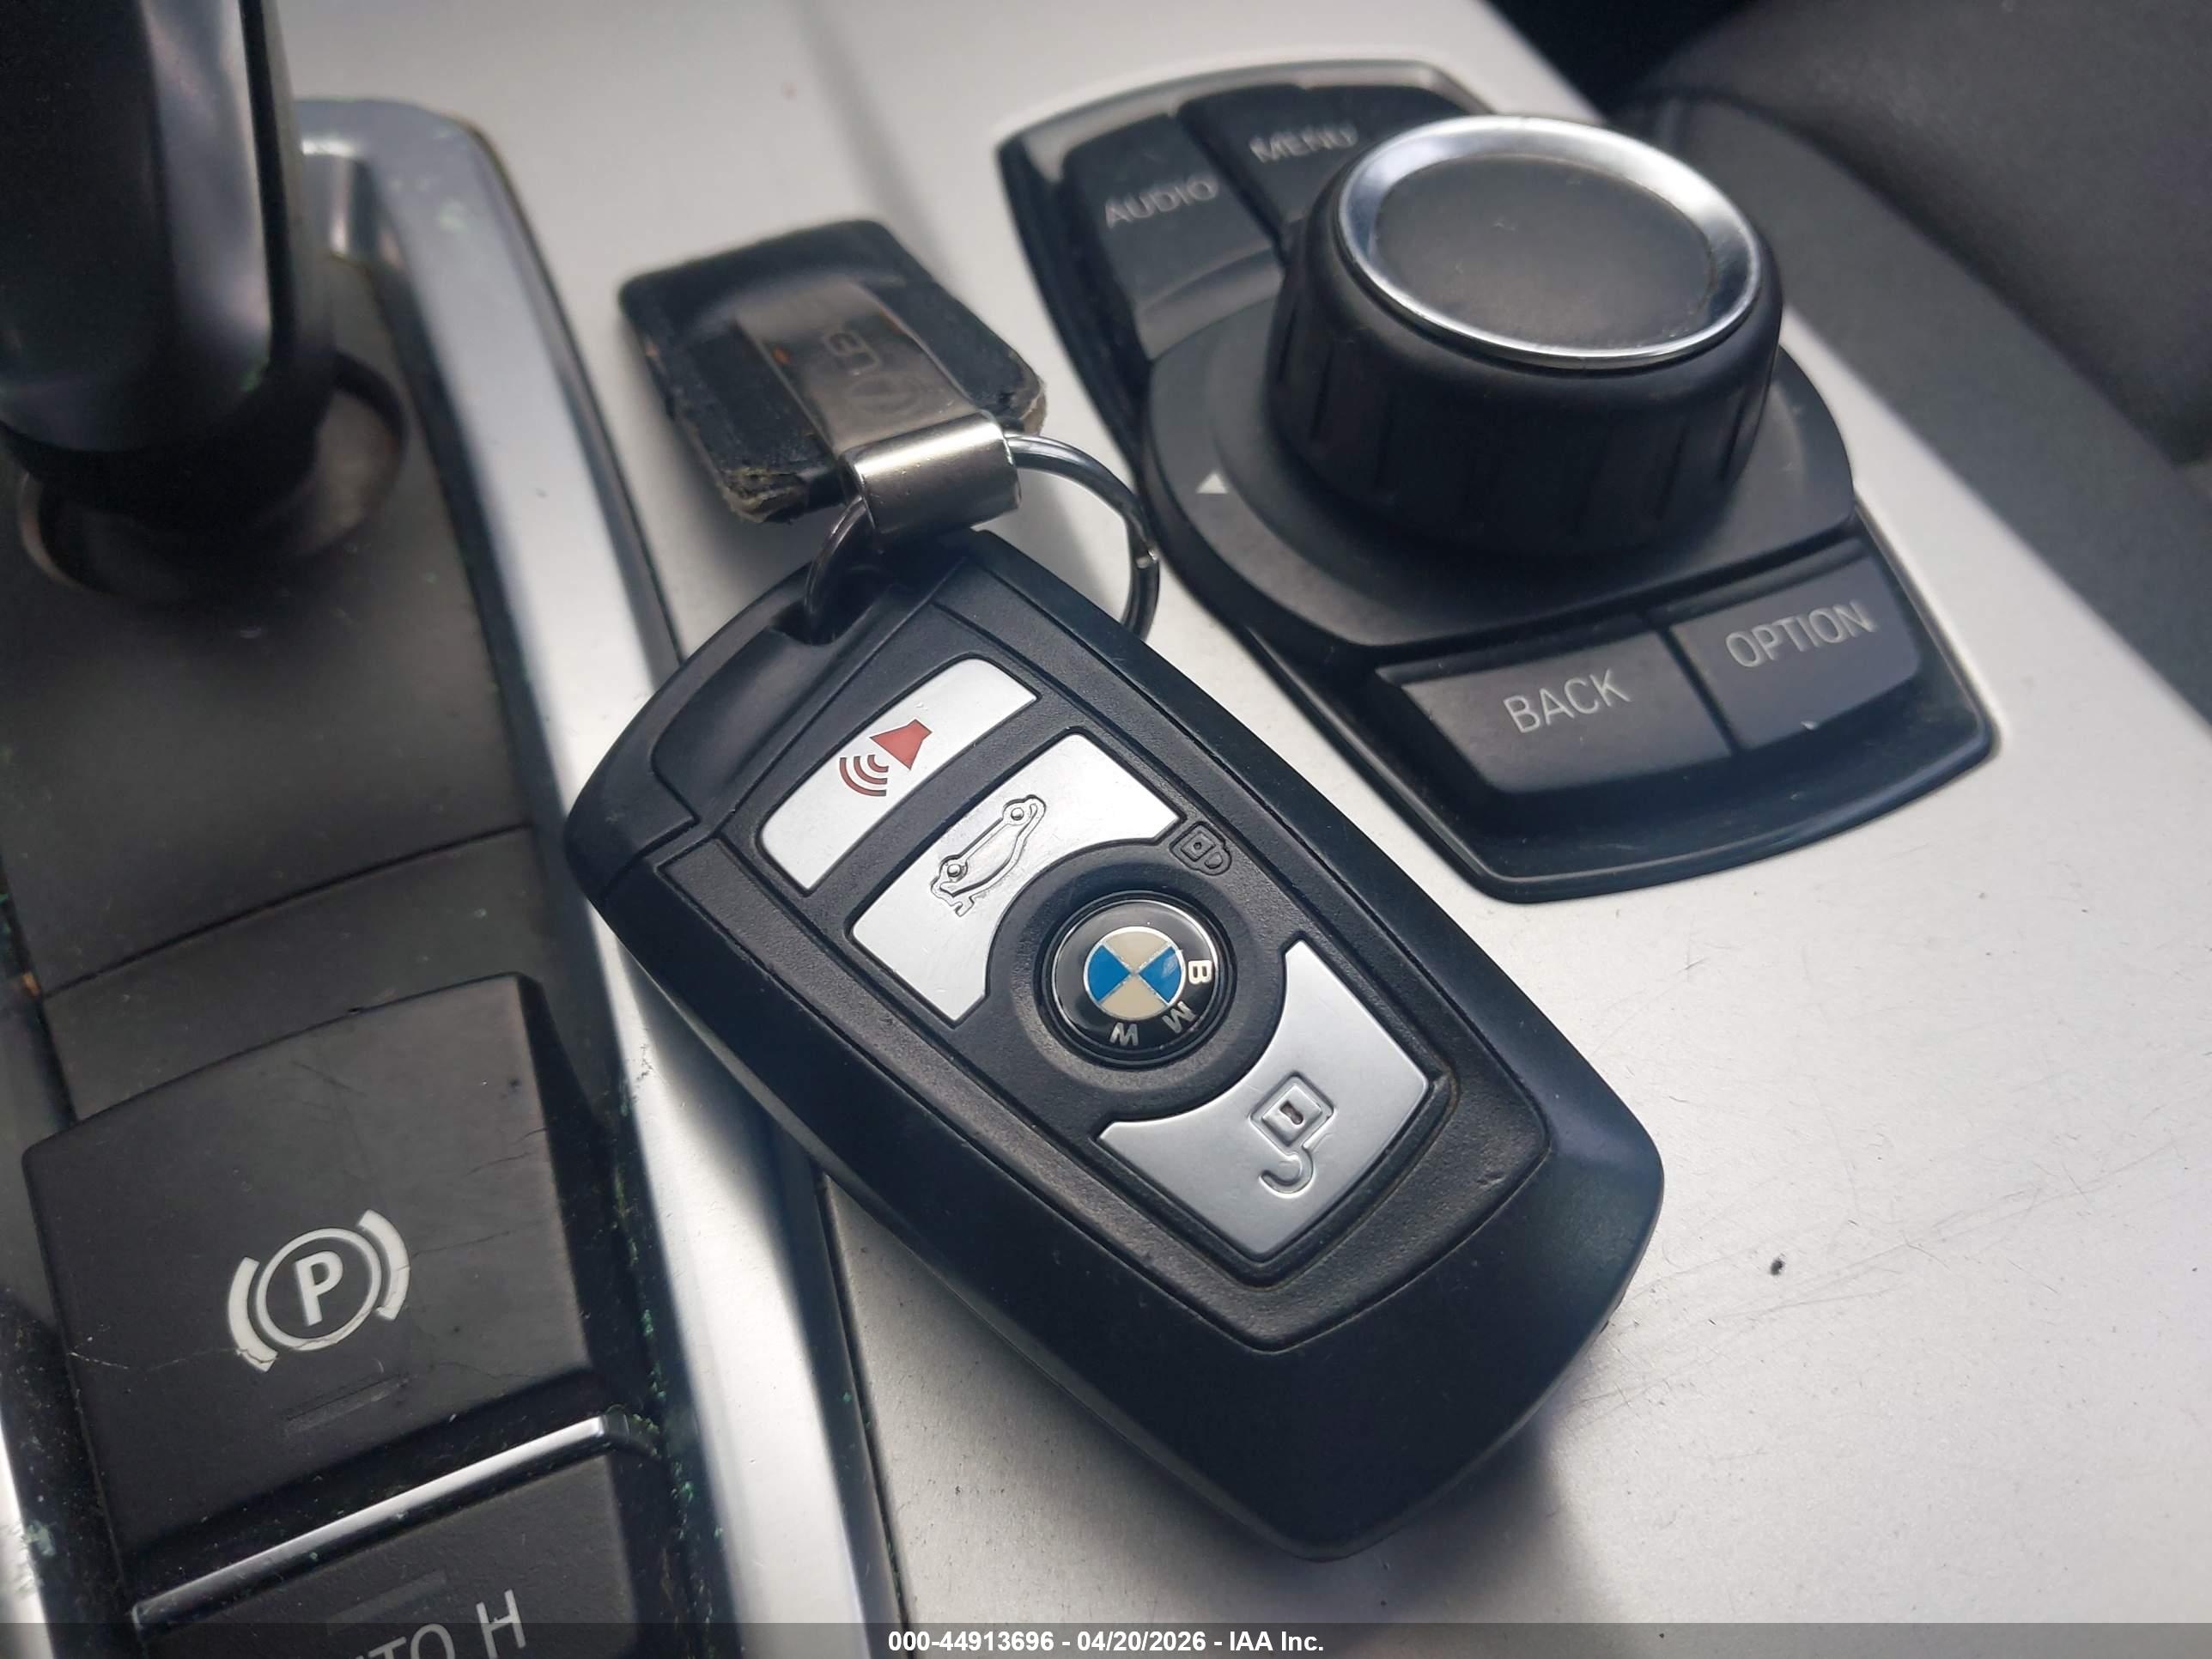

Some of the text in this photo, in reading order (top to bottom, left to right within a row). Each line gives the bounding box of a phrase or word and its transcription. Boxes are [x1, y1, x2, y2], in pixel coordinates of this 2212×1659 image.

[1248, 122, 1359, 163] MENU
[1104, 174, 1219, 229] AUDIO
[1724, 600, 1877, 668] OPTION
[1503, 669, 1630, 734] BACK
[1109, 959, 1212, 1046] BMW
[295, 1250, 344, 1327] P
